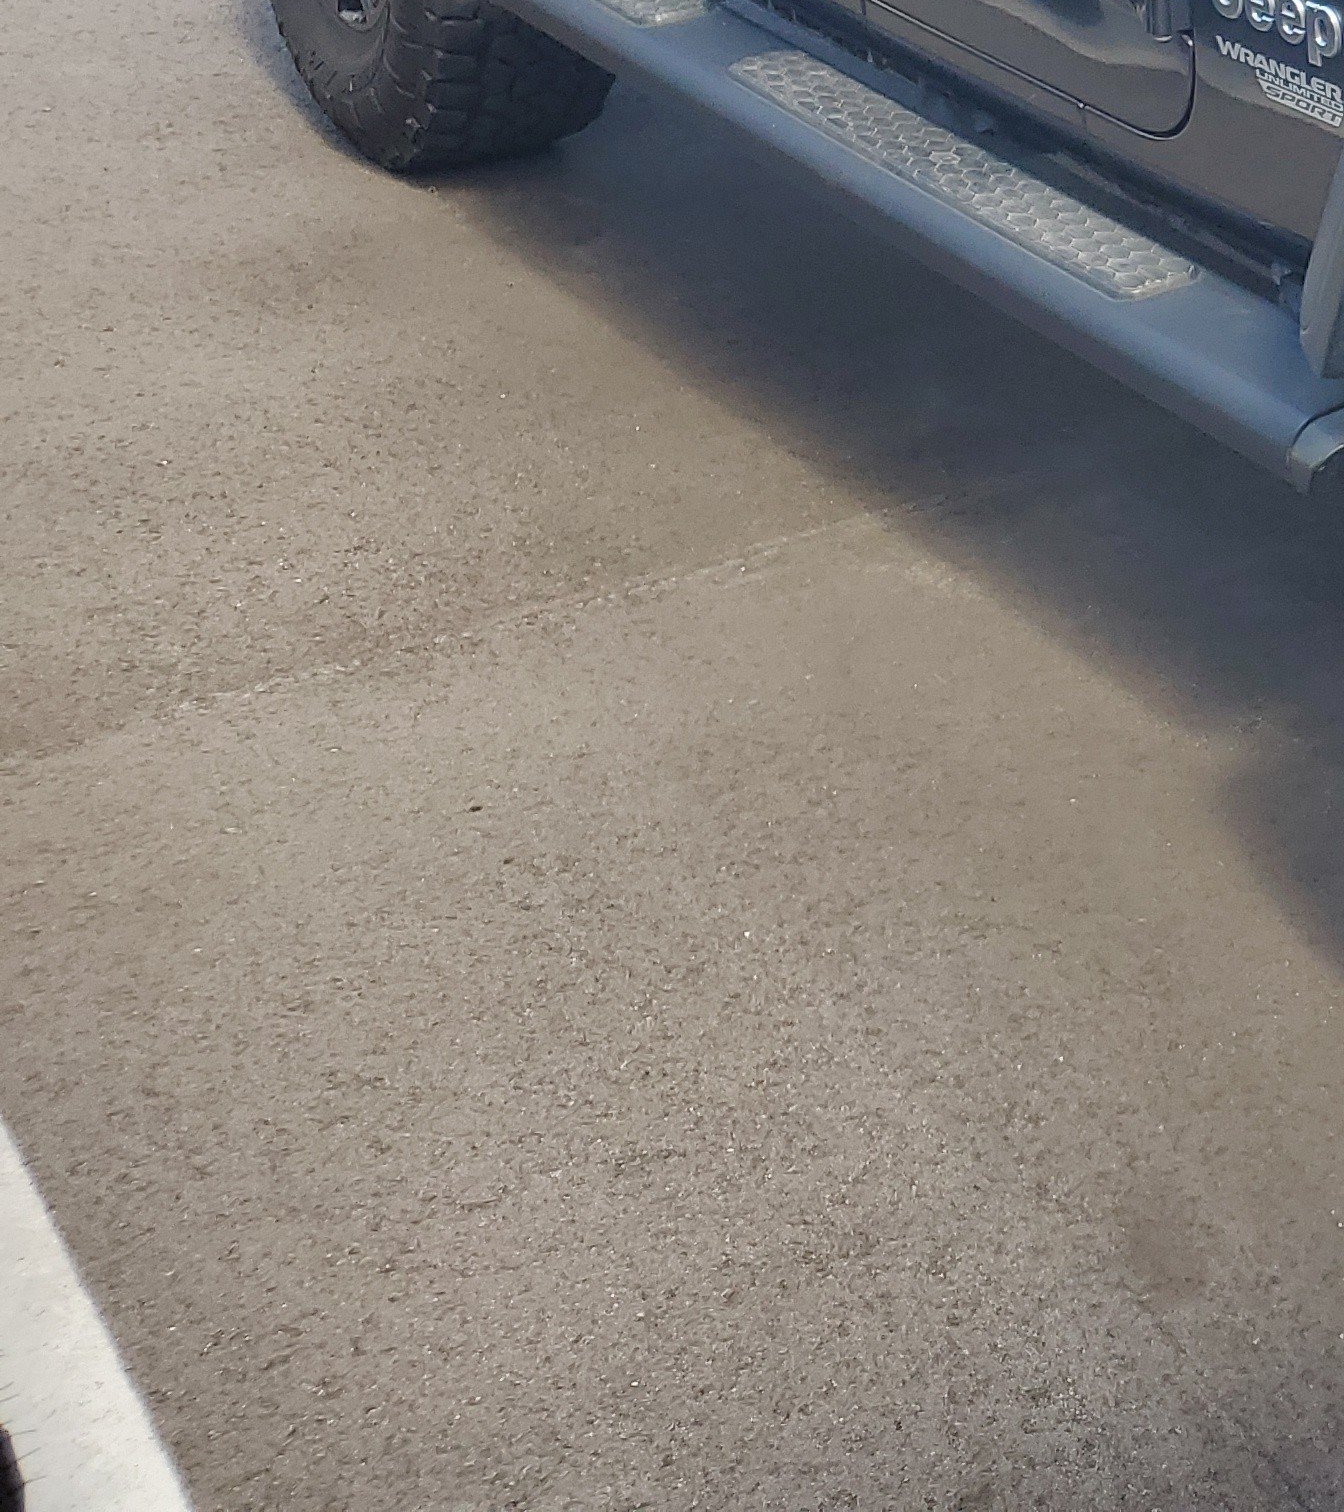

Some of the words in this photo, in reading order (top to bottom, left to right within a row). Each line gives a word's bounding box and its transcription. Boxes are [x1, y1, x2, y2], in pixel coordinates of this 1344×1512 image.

[1214, 34, 1344, 103] WRANGLER
[1255, 68, 1344, 112] UNLIMITED
[1262, 82, 1342, 126] SPORT
